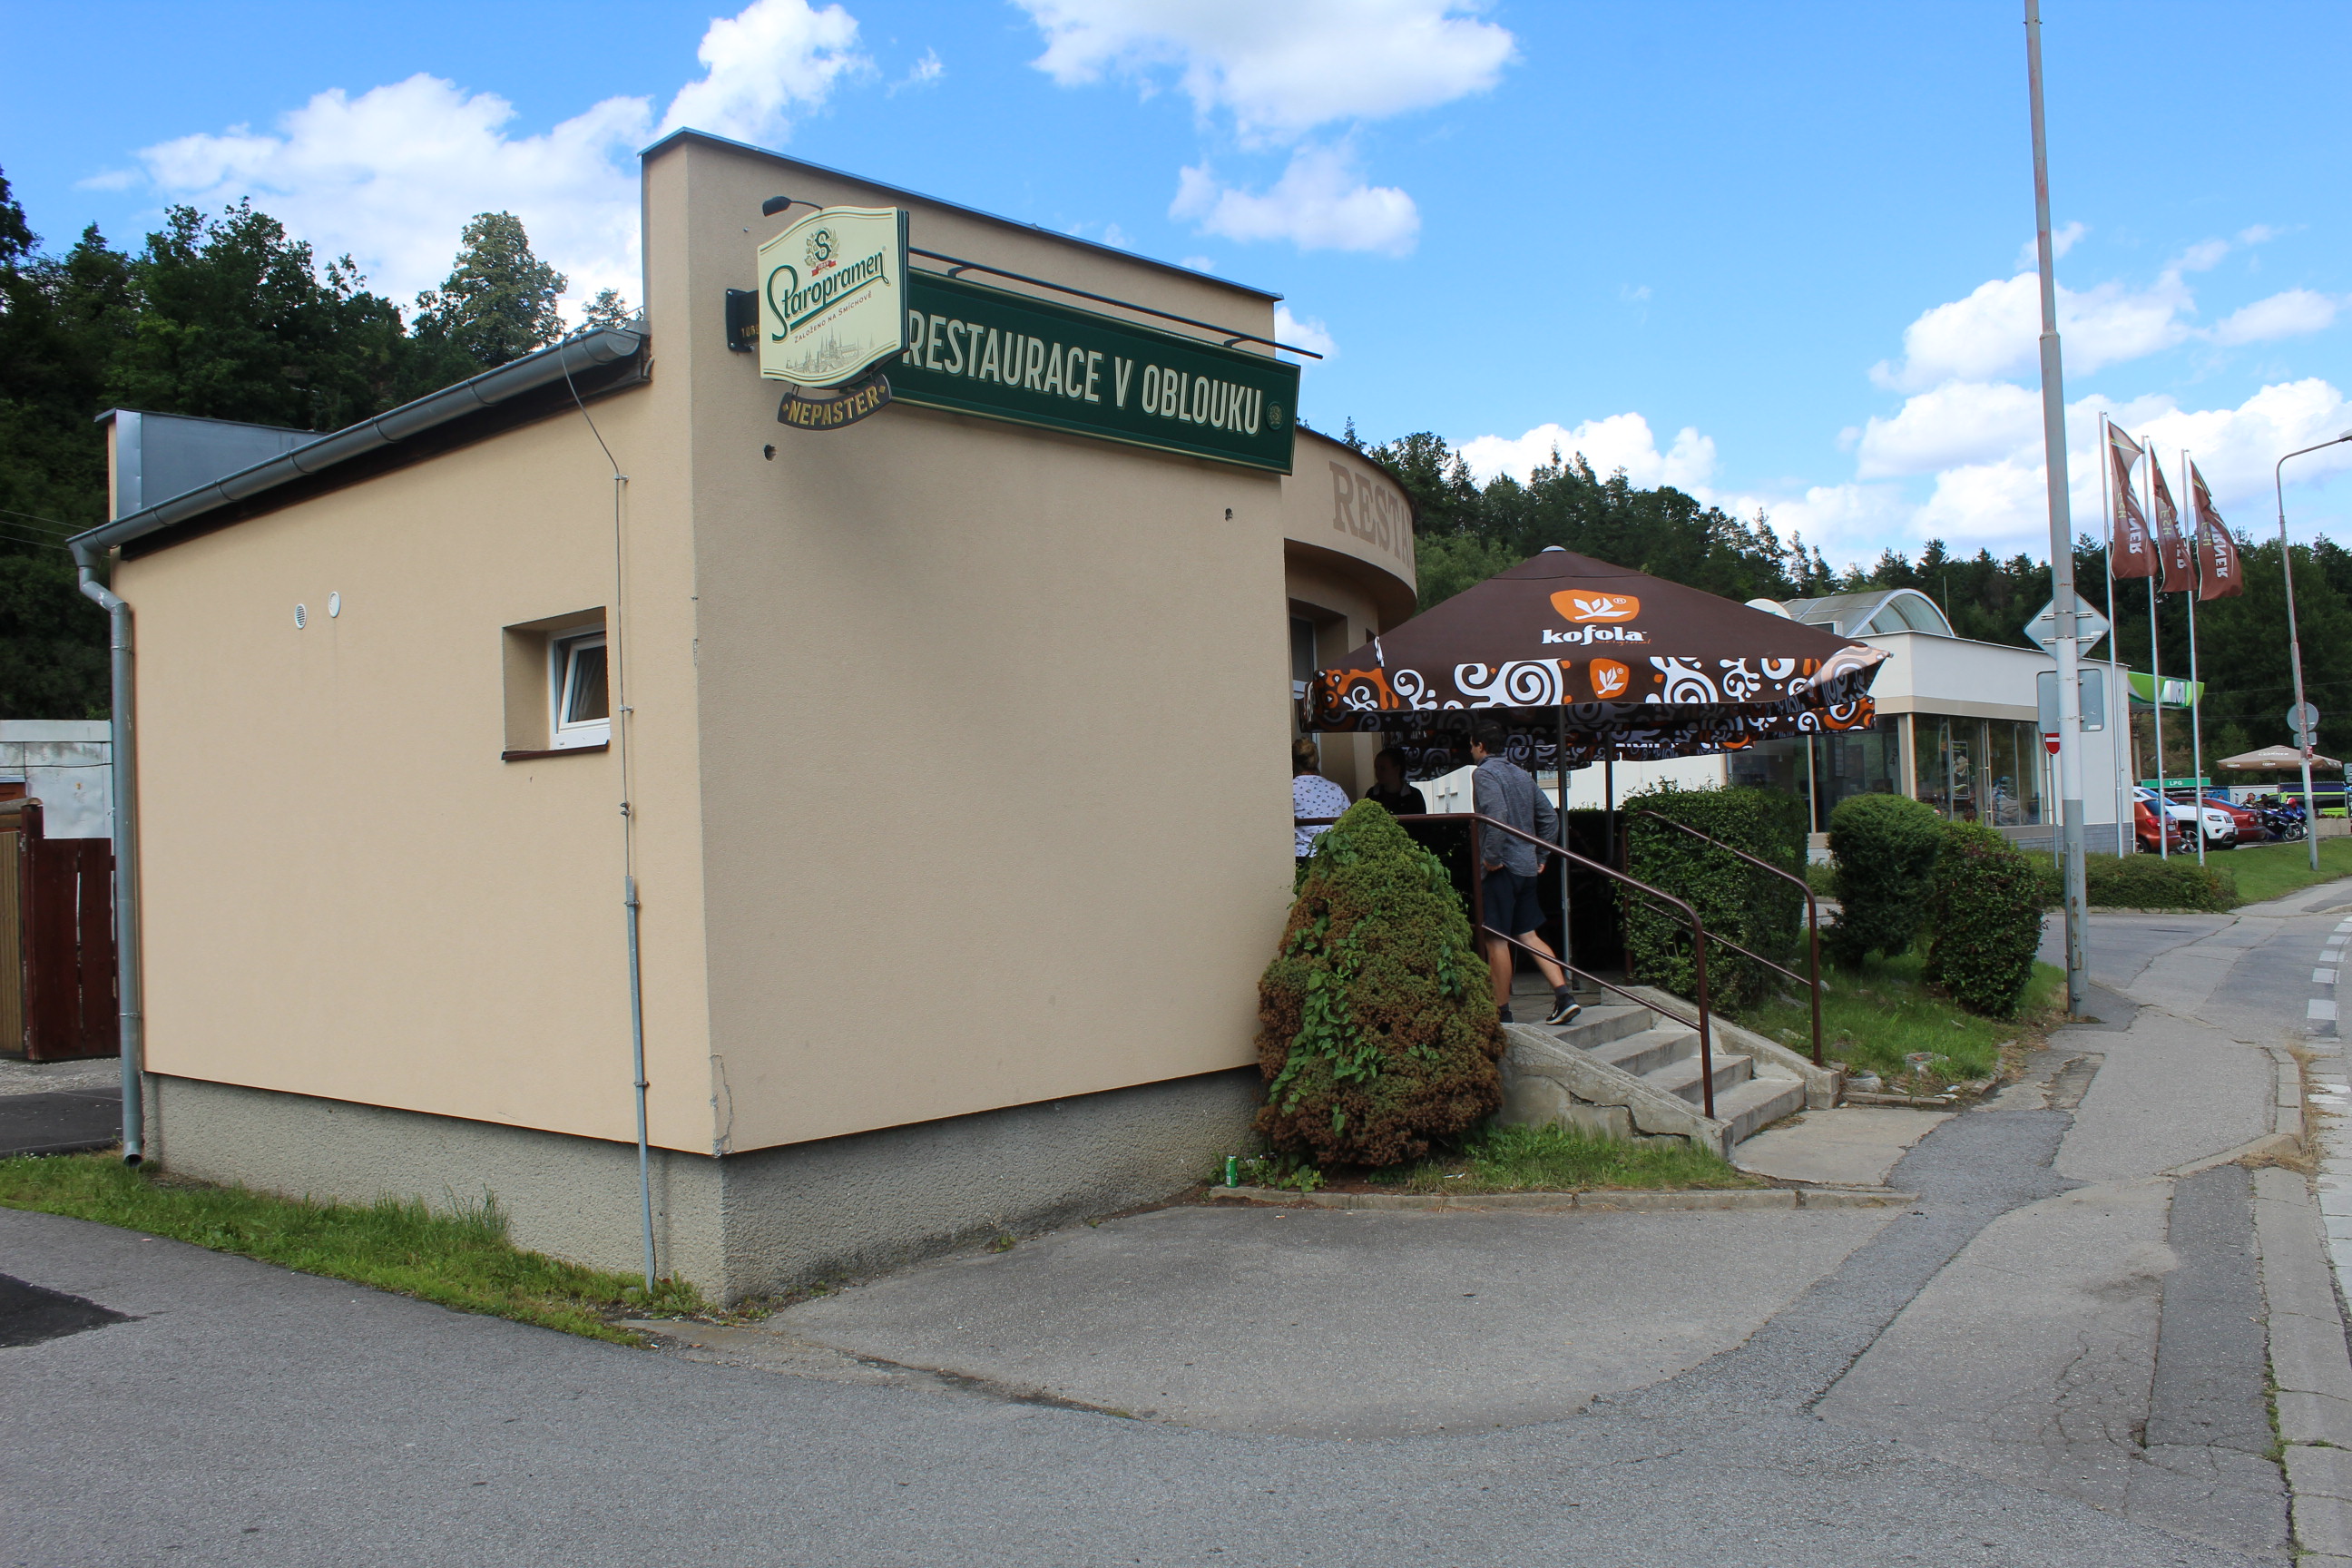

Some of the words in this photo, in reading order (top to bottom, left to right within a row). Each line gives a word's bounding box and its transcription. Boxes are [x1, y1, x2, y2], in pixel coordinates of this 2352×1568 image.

[767, 251, 890, 342] Staropramen
[794, 319, 827, 344] ZALOŽENO
[828, 313, 837, 323] NA
[903, 309, 1103, 405] RESTAURACE
[1114, 356, 1133, 408] V
[1141, 364, 1262, 436] OBLOUKU
[787, 385, 880, 426] NEPASTER
[1542, 624, 1644, 646] kofola
